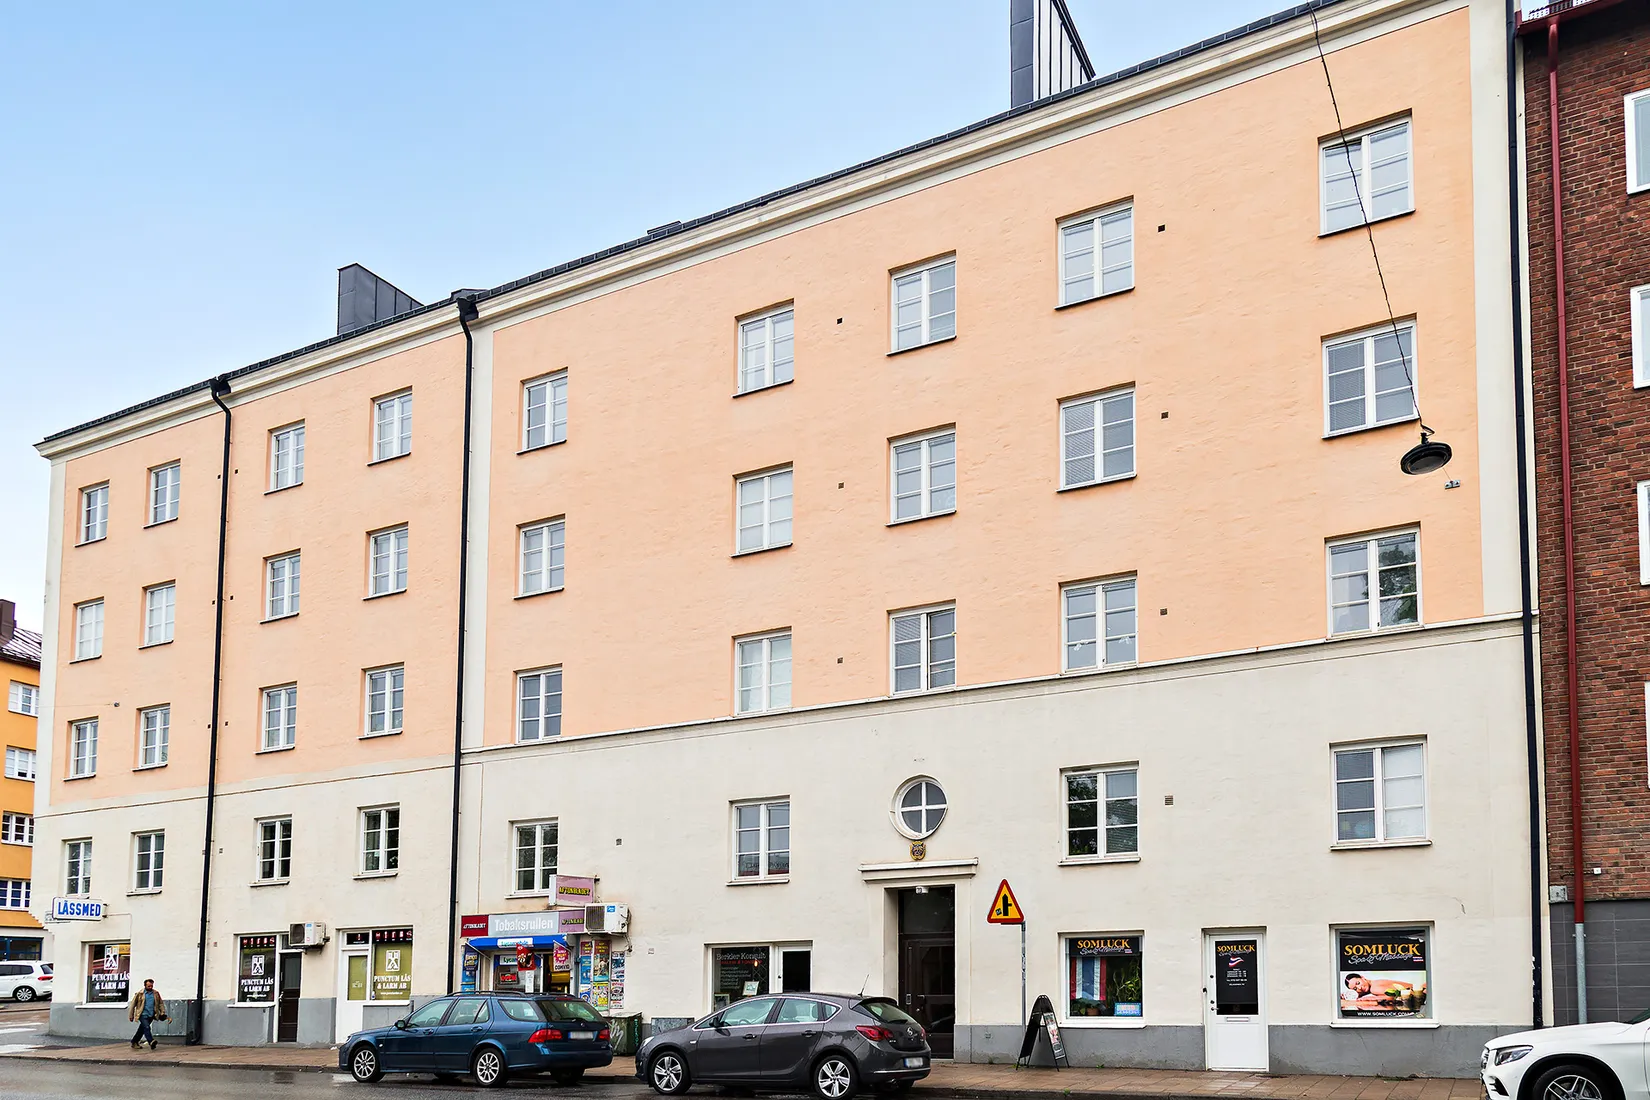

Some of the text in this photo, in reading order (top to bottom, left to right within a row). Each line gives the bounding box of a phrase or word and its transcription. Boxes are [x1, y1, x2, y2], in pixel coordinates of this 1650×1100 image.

[57, 900, 101, 916] LÅSSMED
[494, 917, 554, 932] Tobaksrullen
[1077, 939, 1130, 949] SOMLUCK
[1217, 944, 1256, 952] SOMLUCK
[1344, 943, 1420, 955] SOMLUCK
[1348, 955, 1366, 965] Spa
[92, 973, 119, 981] PUNCTUM
[264, 977, 274, 985] LÅS
[374, 973, 412, 983] PUNCTUM LÅS
[95, 982, 100, 990] &
